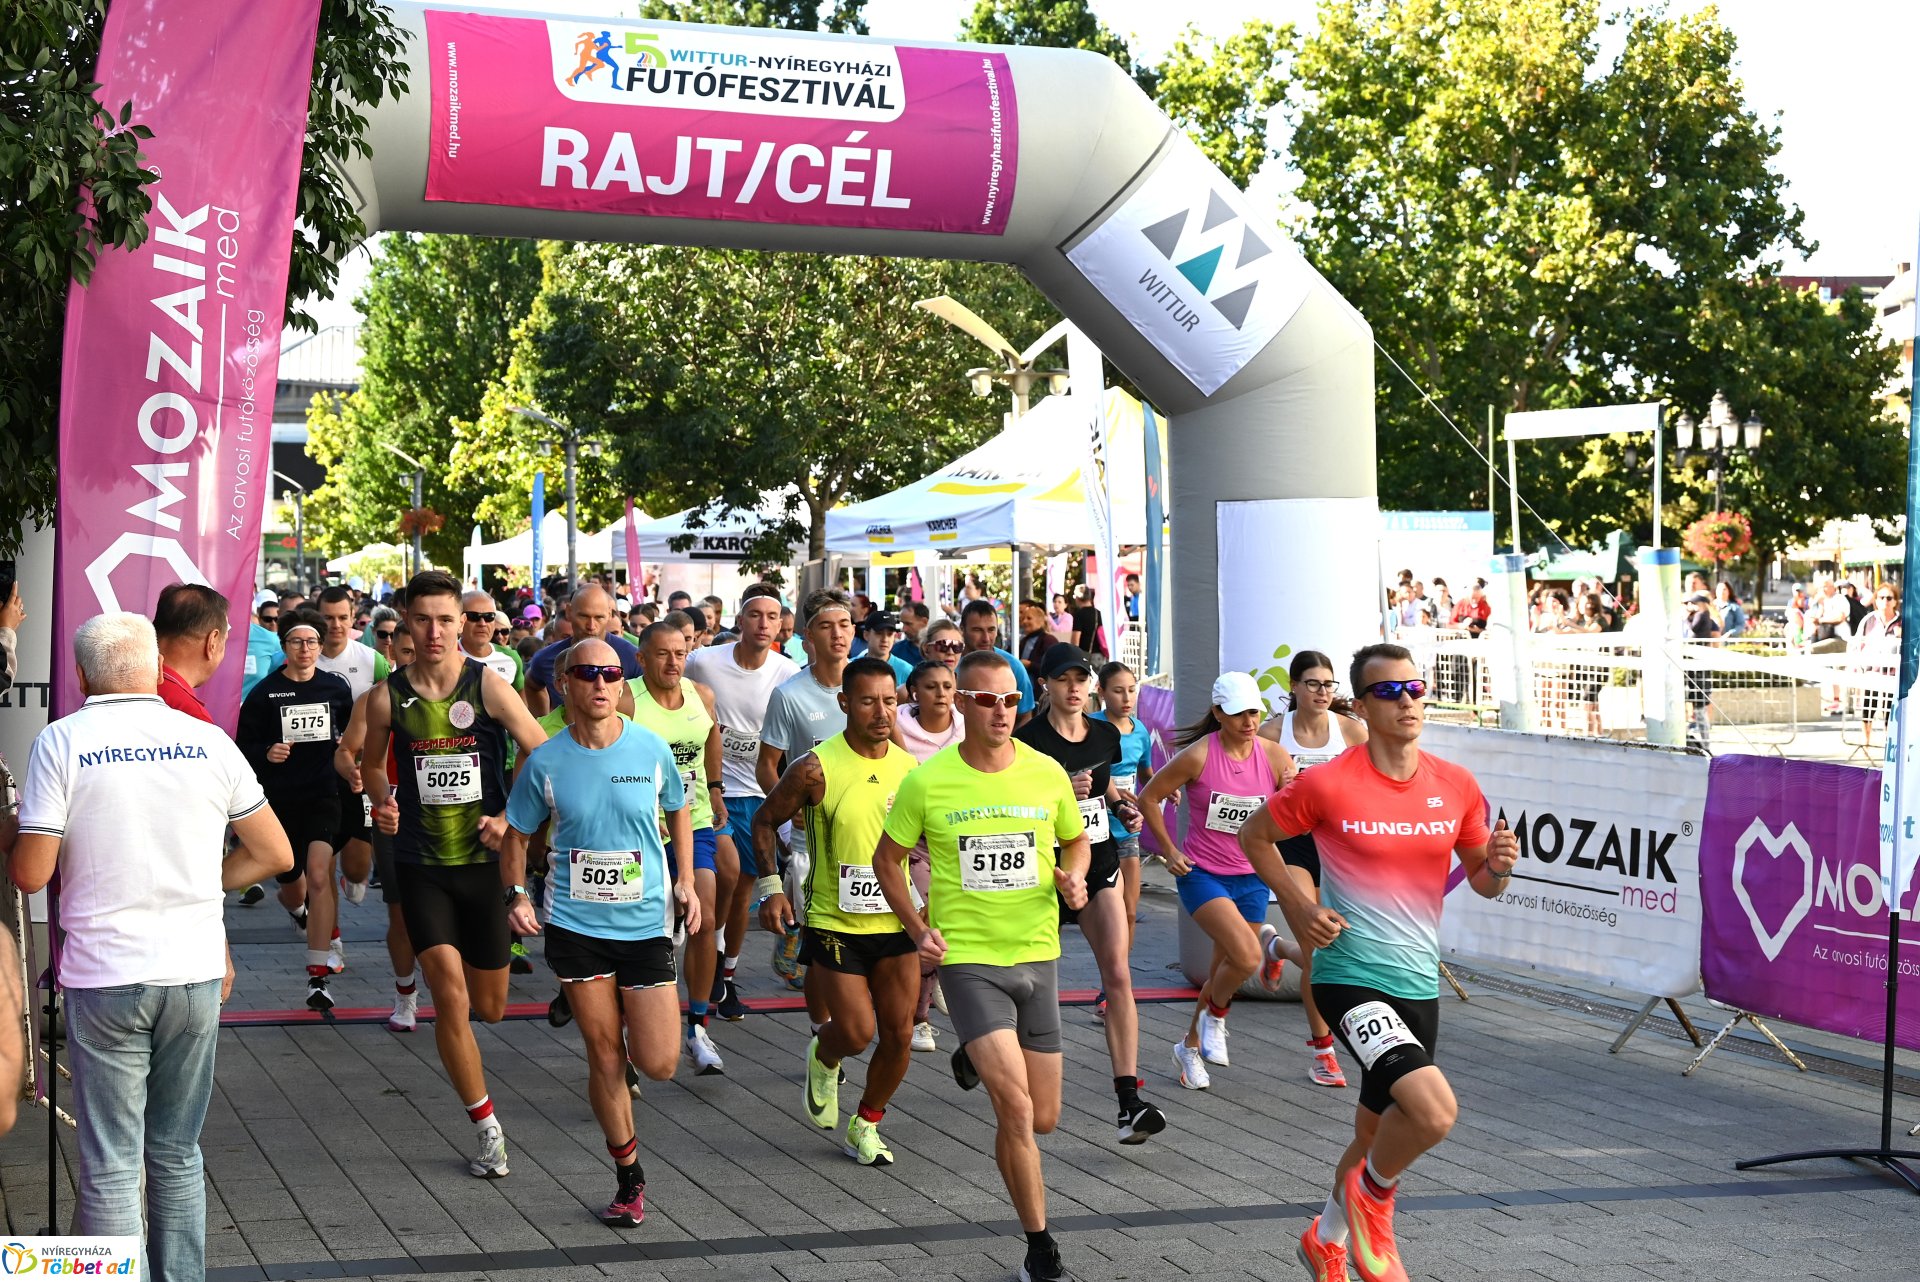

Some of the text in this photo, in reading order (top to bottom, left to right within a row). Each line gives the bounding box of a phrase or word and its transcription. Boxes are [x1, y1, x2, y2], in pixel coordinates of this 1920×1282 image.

[669, 48, 892, 78] WITTUR-NYÍREGYHÁZI
[447, 41, 461, 159] www.mozaikmed.hu
[626, 66, 895, 110] FUTÓFESZTIVÁL
[982, 58, 1003, 226] www.nyiregyhazifutofesztival.hu
[540, 126, 911, 209] RAJT/CÉL
[212, 205, 240, 299] med
[1138, 268, 1200, 333] WITTUR
[125, 190, 210, 533] MOZAIK
[226, 309, 265, 541] Az orvosi futóközösség
[290, 715, 324, 730] 5175
[78, 742, 208, 768] NYÍREGYHÁZA
[723, 737, 757, 752] 5058
[426, 770, 471, 788] 5025
[1217, 807, 1256, 822] 509
[1342, 819, 1457, 836] HUNGARY
[972, 851, 1025, 872] 5188
[1507, 892, 1538, 910] orvosi
[1541, 897, 1617, 928] futóközösség
[1621, 884, 1677, 914] med
[1812, 943, 1829, 961] Az
